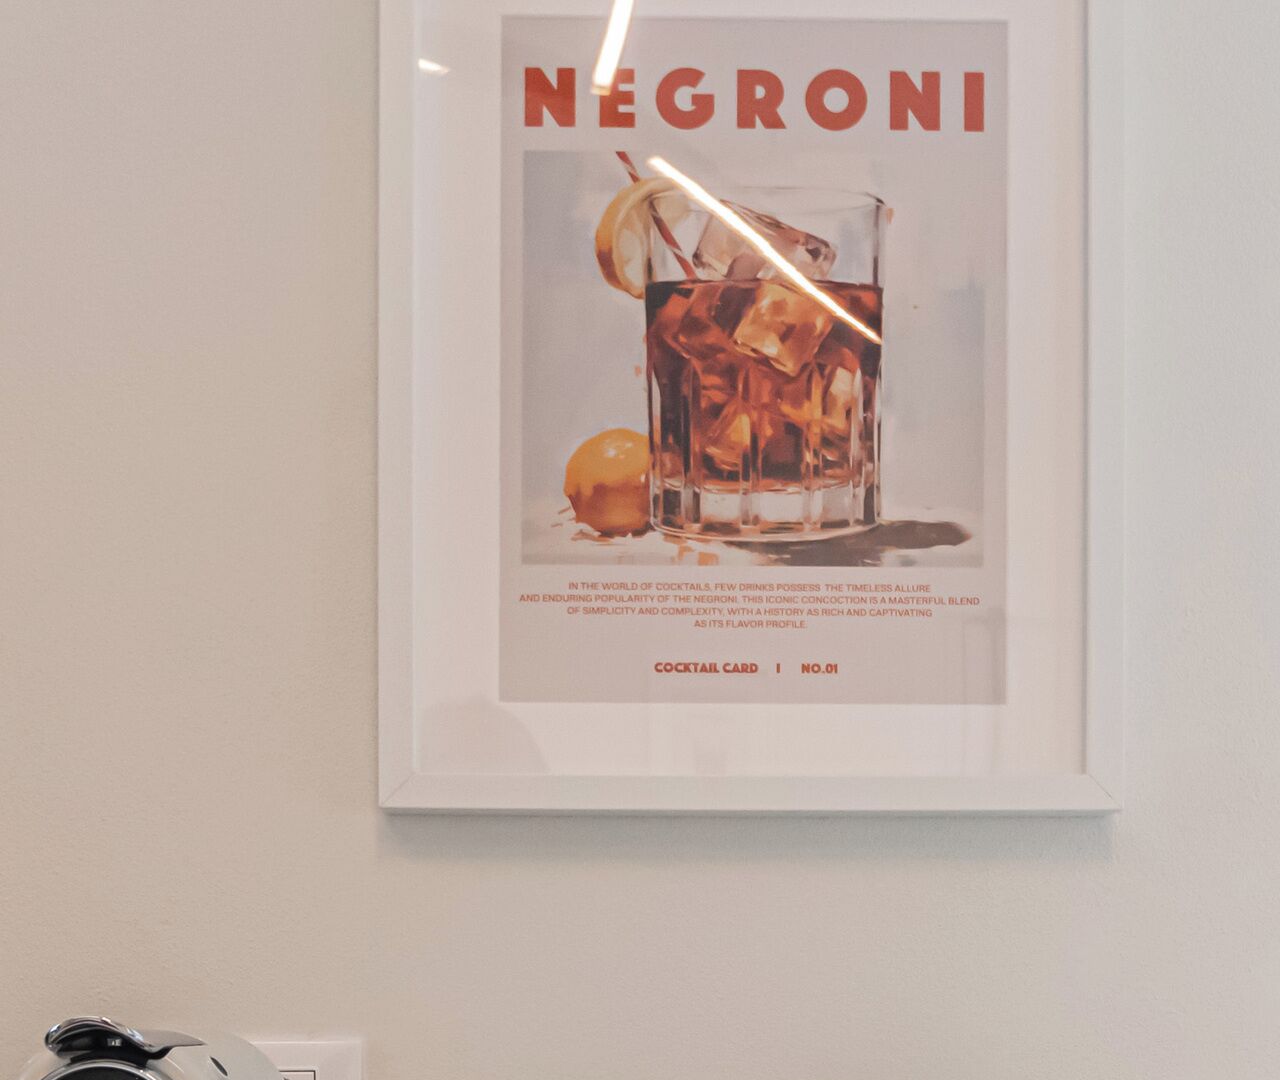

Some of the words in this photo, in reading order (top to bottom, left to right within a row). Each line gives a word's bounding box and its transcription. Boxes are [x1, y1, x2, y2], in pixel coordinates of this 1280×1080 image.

[524, 67, 985, 132] NEGRONI
[568, 582, 578, 591] IN
[580, 582, 598, 591] THE
[601, 582, 638, 591] WORLD
[640, 582, 653, 591] OF
[714, 583, 736, 592] FEW
[738, 583, 774, 592] DRINKS
[776, 583, 821, 592] POSSESS
[825, 584, 843, 592] THE
[846, 584, 893, 593] TIMELESS
[894, 584, 931, 593] ALLURE
[519, 594, 540, 603] AND
[542, 594, 593, 603] ENDURING
[595, 595, 654, 604] POPULARITY
[657, 595, 670, 604] OF
[673, 595, 691, 604] THE
[742, 595, 764, 604] THIS
[766, 596, 799, 604] ICONIC
[801, 596, 867, 605] CONCOCTION
[869, 596, 878, 605] IS
[880, 596, 887, 605] A
[888, 596, 946, 605] MASTERFUL
[948, 597, 980, 606] BLEND
[567, 606, 580, 615] OF
[582, 606, 636, 615] SIMPLICITY
[638, 607, 659, 615] AND
[727, 607, 754, 616] WITH
[756, 607, 763, 616] A
[764, 608, 805, 616] HISTORY
[806, 608, 820, 617] AS
[821, 608, 845, 617] RICH
[846, 608, 867, 617] AND
[869, 608, 933, 617] CAPTIVATING
[694, 619, 707, 628] AS
[708, 619, 724, 628] ITS
[725, 619, 764, 628] FLAVOR
[654, 662, 720, 674] COCKTAIL
[723, 663, 759, 674] CARD
[801, 663, 838, 674] NO.01
